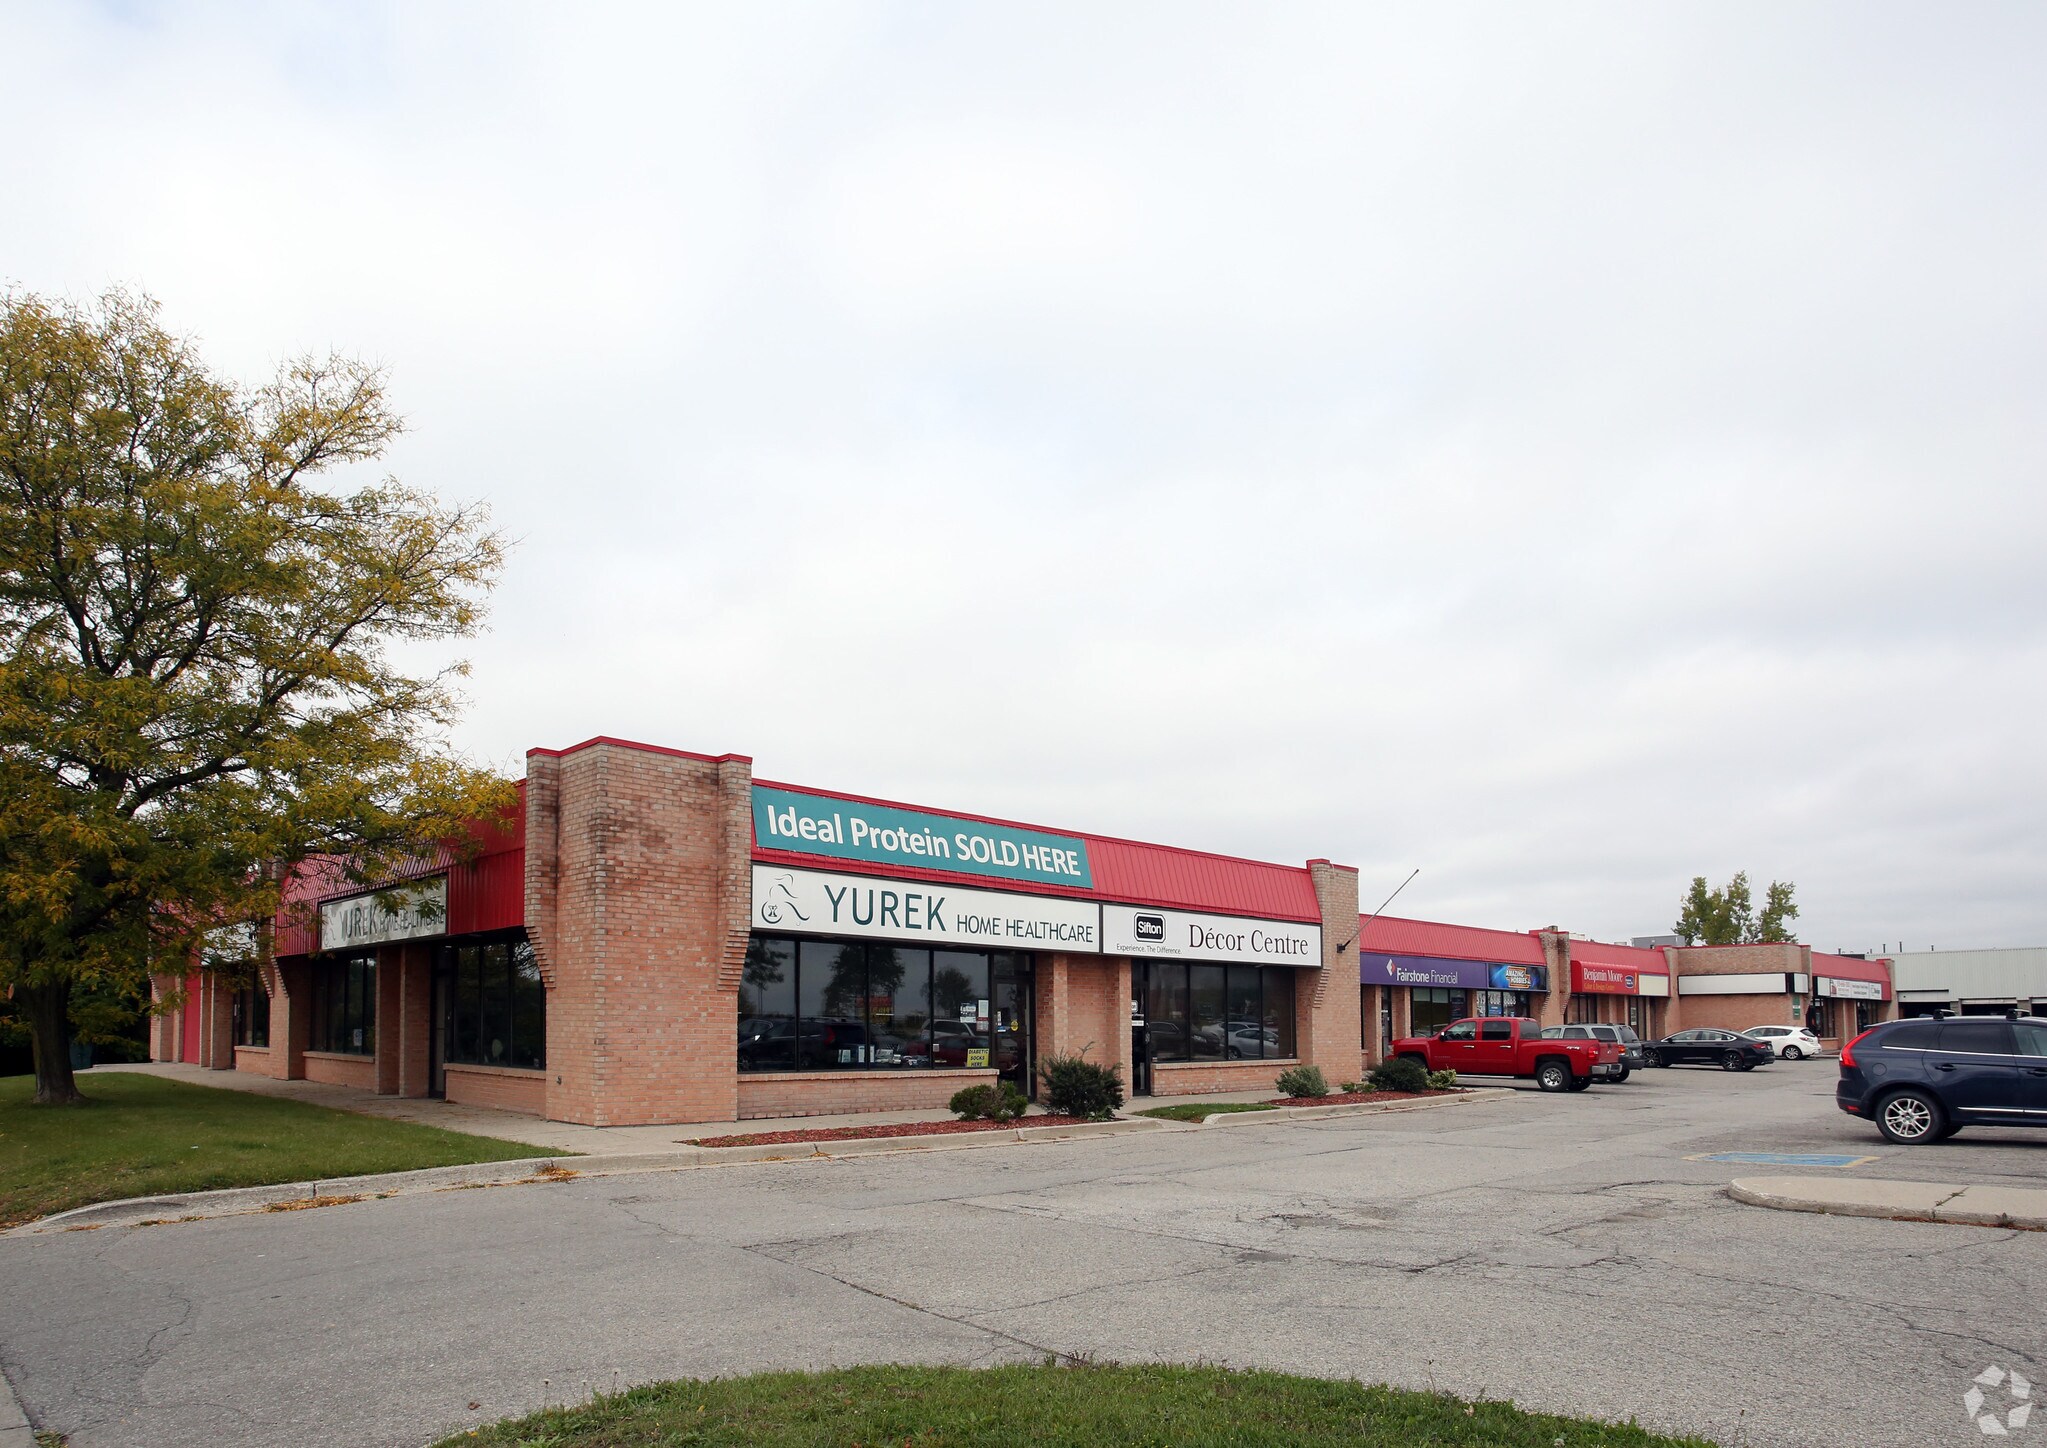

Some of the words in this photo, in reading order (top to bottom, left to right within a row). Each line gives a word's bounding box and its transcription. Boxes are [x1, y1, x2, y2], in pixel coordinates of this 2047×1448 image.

[767, 804, 844, 844] Ideal
[850, 817, 951, 859] Protein
[954, 832, 1020, 867] SOLD
[1021, 843, 1082, 876] HERE
[823, 884, 947, 932] YUREK
[957, 914, 1001, 936] HOME
[1006, 918, 1094, 943] HEALTHCARE
[1137, 920, 1162, 935] Sifton
[1189, 924, 1245, 951] Décor
[1251, 929, 1309, 955] Centre
[1147, 945, 1156, 953] The
[1396, 967, 1430, 983] Fairstone
[1430, 969, 1458, 985] Financial
[1583, 967, 1607, 983] Benjamin
[1607, 969, 1623, 982] Moore
